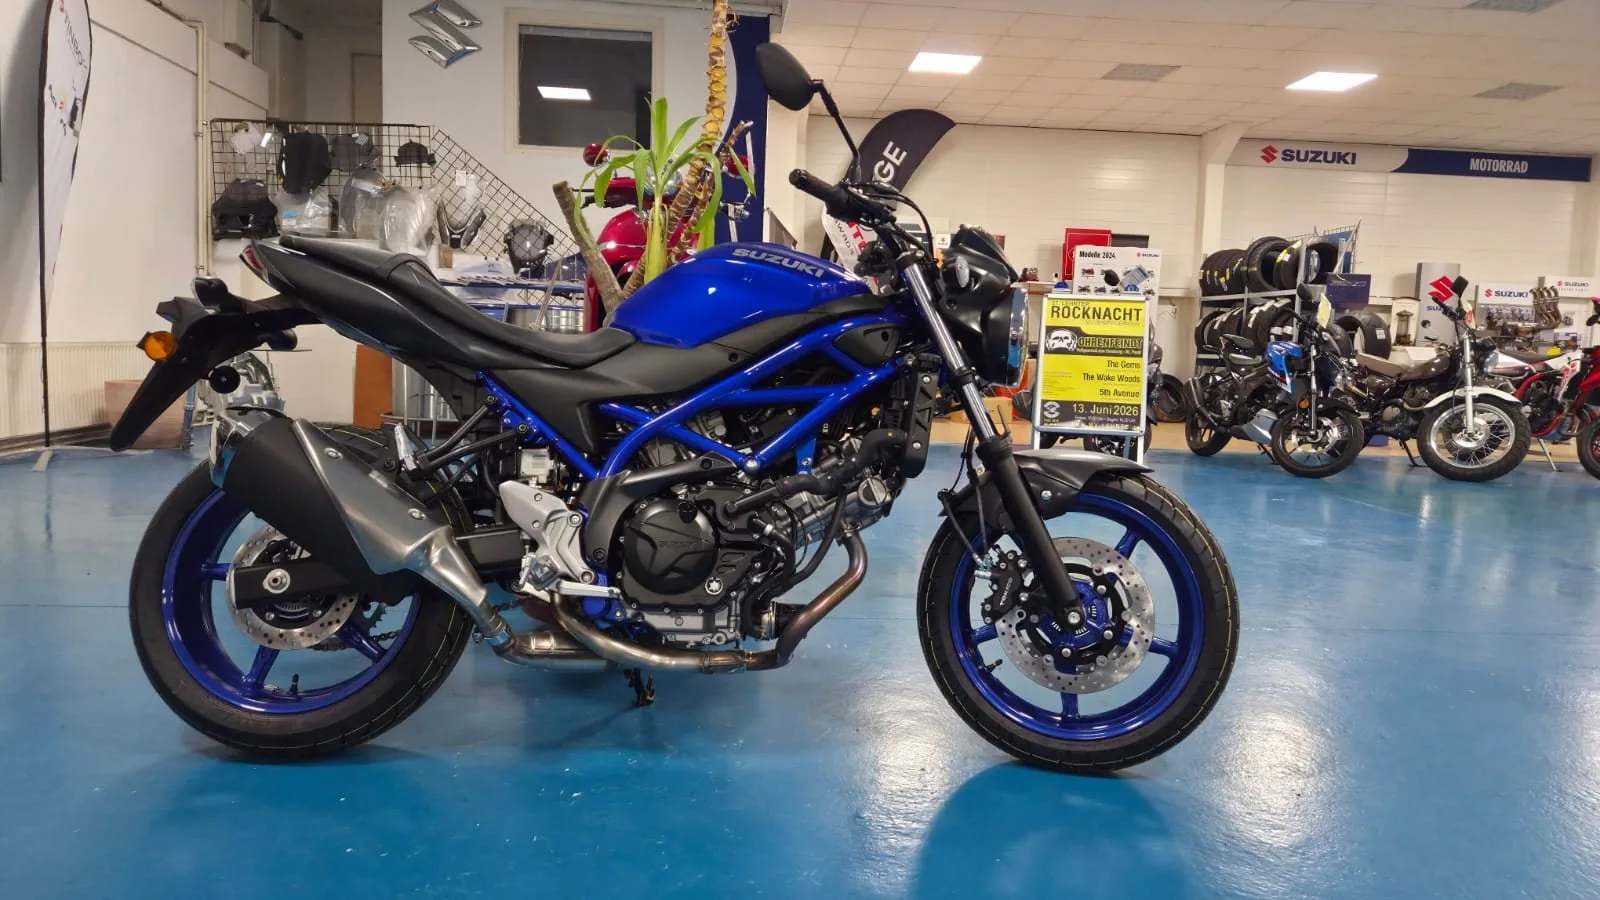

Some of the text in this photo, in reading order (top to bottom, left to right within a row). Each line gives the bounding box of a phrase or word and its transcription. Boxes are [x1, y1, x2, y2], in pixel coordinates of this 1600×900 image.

[872, 140, 908, 183] GE
[1280, 148, 1357, 165] SUZUKI
[1469, 157, 1529, 174] MOTORRAD
[1079, 250, 1116, 259] Modelle 2024
[731, 248, 825, 278] SUZUKI
[1494, 290, 1529, 298] SUZUKI
[1050, 305, 1143, 321] ROCKNACHT
[1078, 337, 1143, 350] OHRENFEINDT
[1107, 360, 1119, 368] The
[1083, 373, 1141, 383] The Wake Woods
[1100, 388, 1140, 398] 5th Avenue
[1072, 403, 1139, 416] 13. Juni 2026
